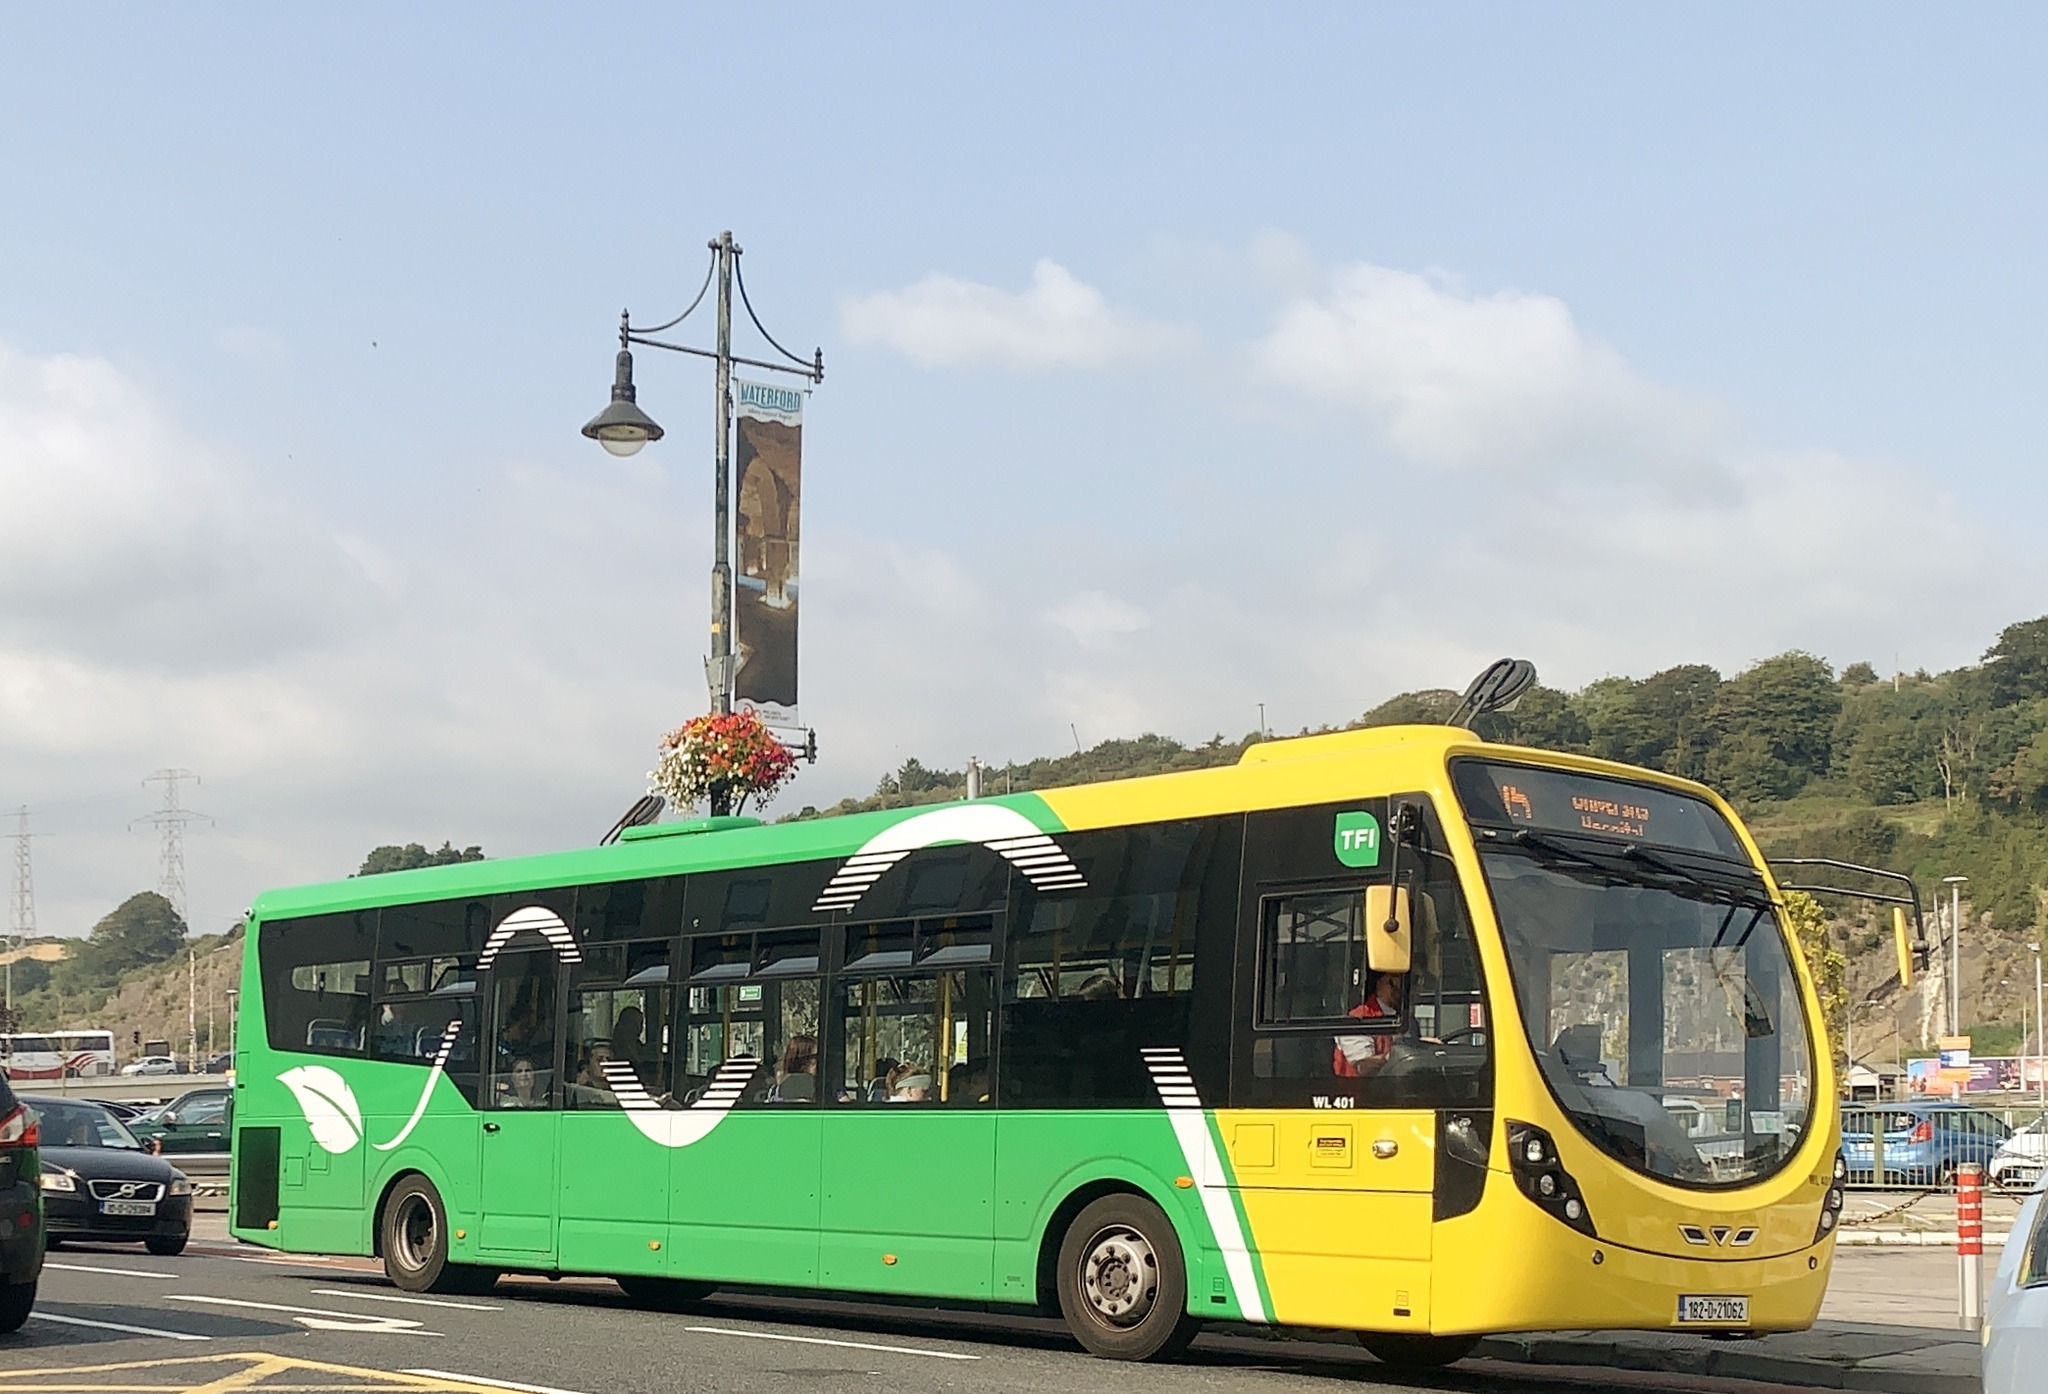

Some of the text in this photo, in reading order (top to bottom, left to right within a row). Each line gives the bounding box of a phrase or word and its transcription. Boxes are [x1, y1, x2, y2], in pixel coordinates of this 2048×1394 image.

[741, 383, 801, 409] WATERFORD
[1341, 829, 1375, 850] TFI
[1312, 1096, 1354, 1109] WL 401
[1688, 1301, 1744, 1319] 182-D-21062
